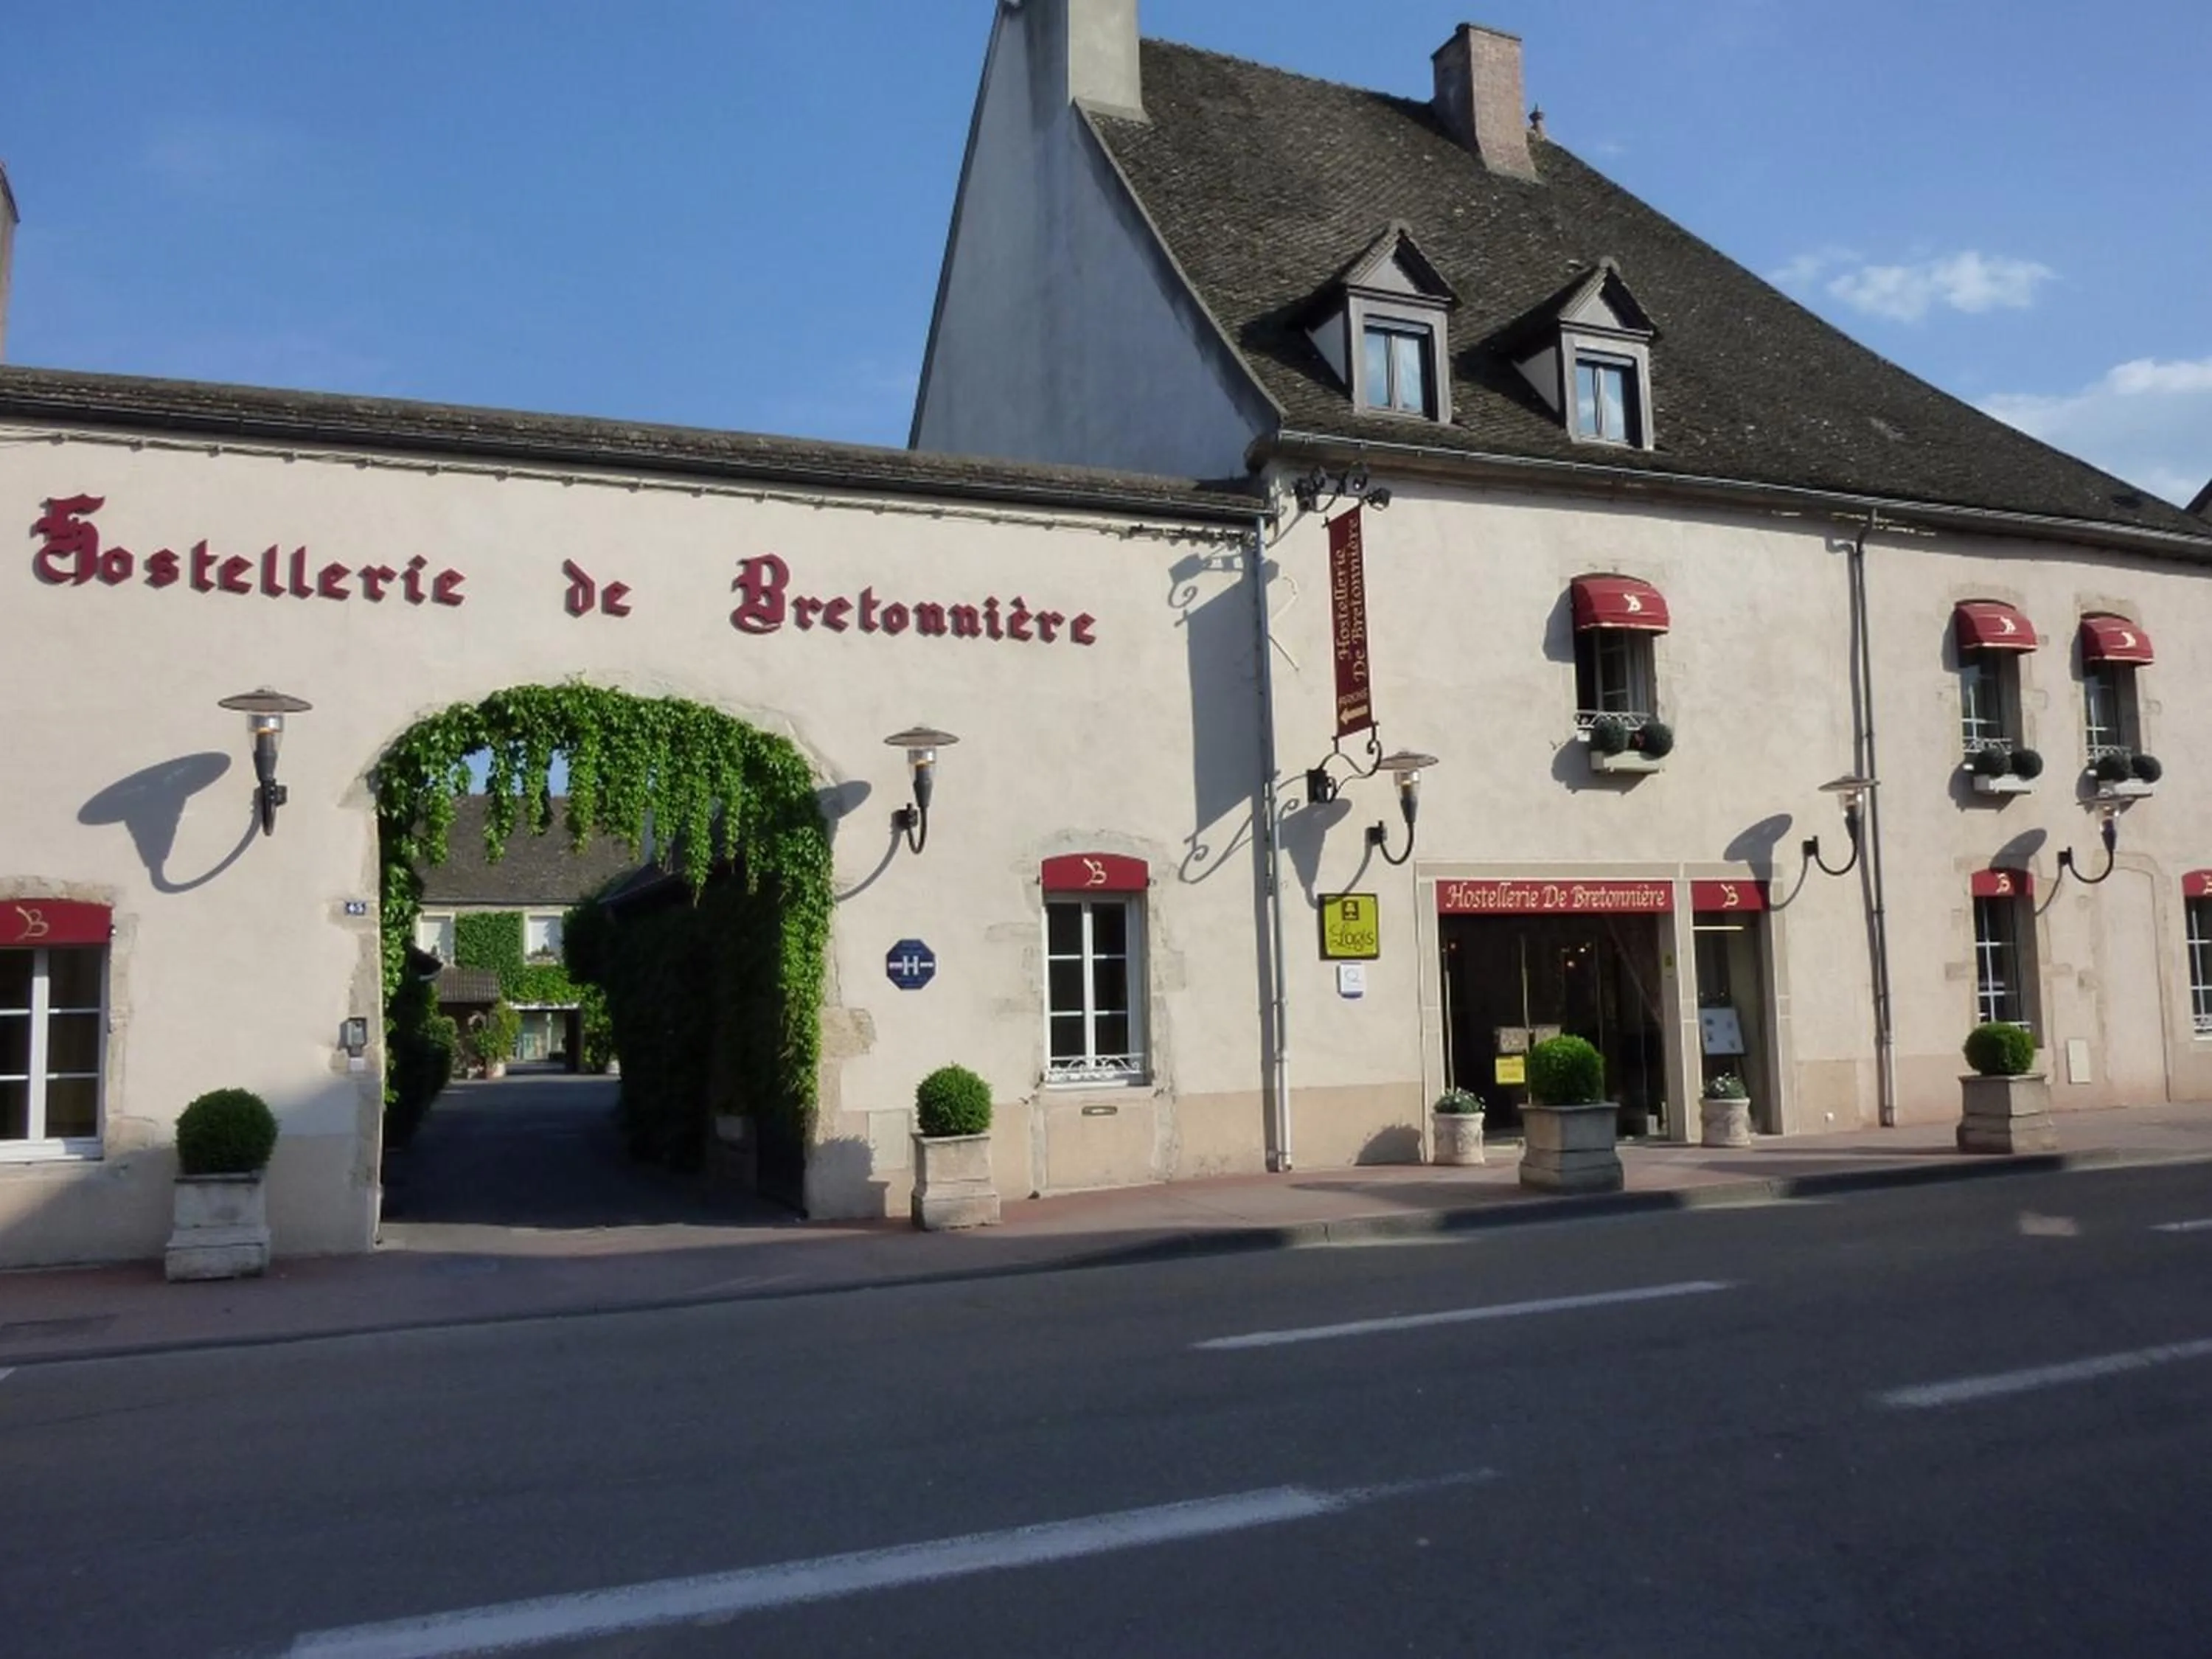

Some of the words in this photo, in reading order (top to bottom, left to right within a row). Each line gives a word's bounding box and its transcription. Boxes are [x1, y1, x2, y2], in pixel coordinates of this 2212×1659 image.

[563, 558, 632, 618] de
[730, 553, 1096, 645] Bretonnière
[1335, 549, 1350, 661] Hostellerie
[1352, 650, 1368, 683] De
[1445, 882, 1538, 908] Hostellerie
[1542, 884, 1567, 908] De
[1571, 884, 1666, 908] Bretonnière
